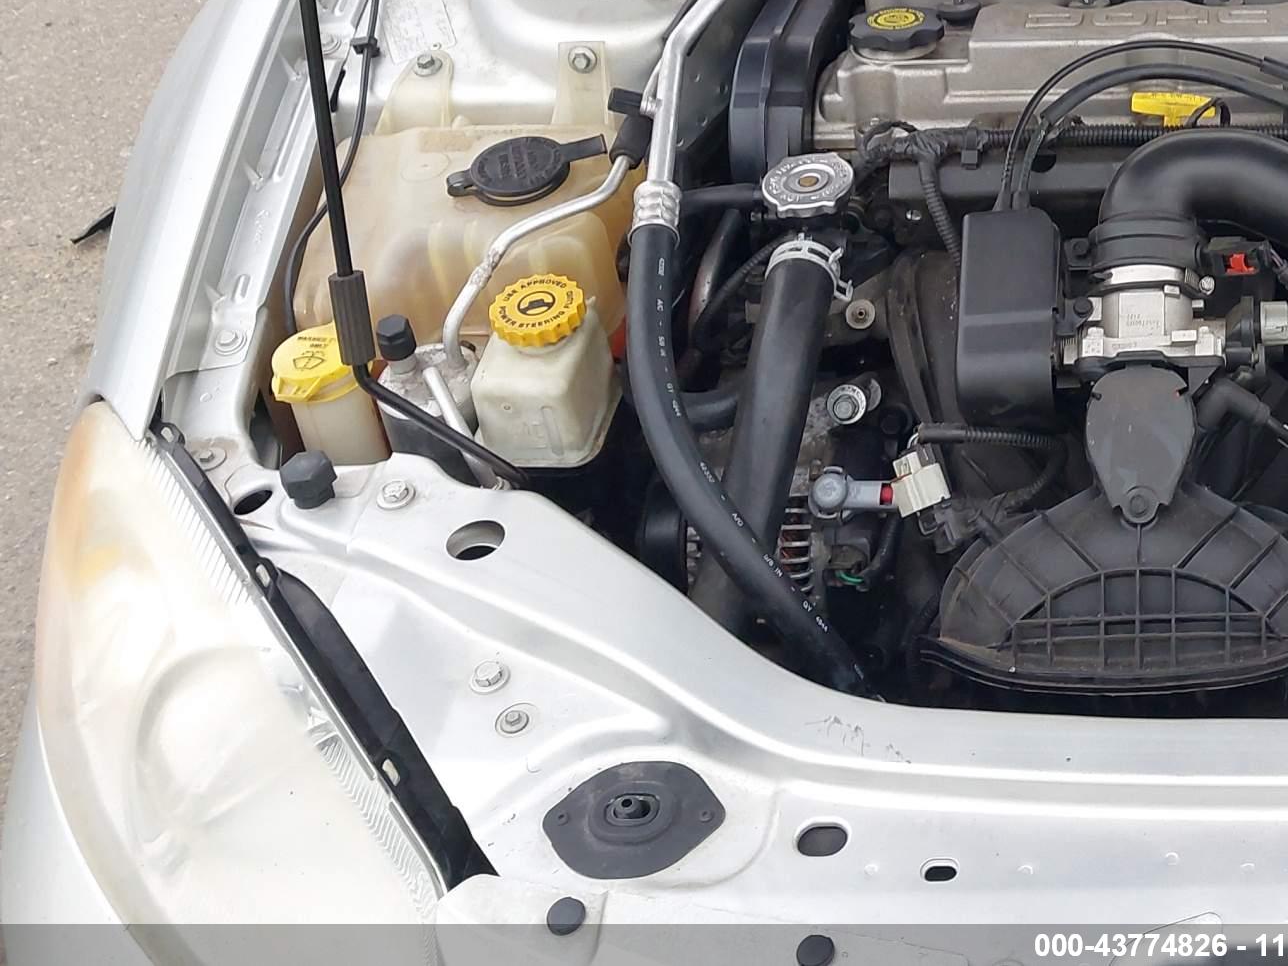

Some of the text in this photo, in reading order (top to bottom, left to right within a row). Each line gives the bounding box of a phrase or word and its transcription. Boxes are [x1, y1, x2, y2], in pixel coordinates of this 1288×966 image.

[520, 278, 567, 291] APPROVED
[498, 305, 518, 327] POWER
[518, 310, 566, 329] STEERING
